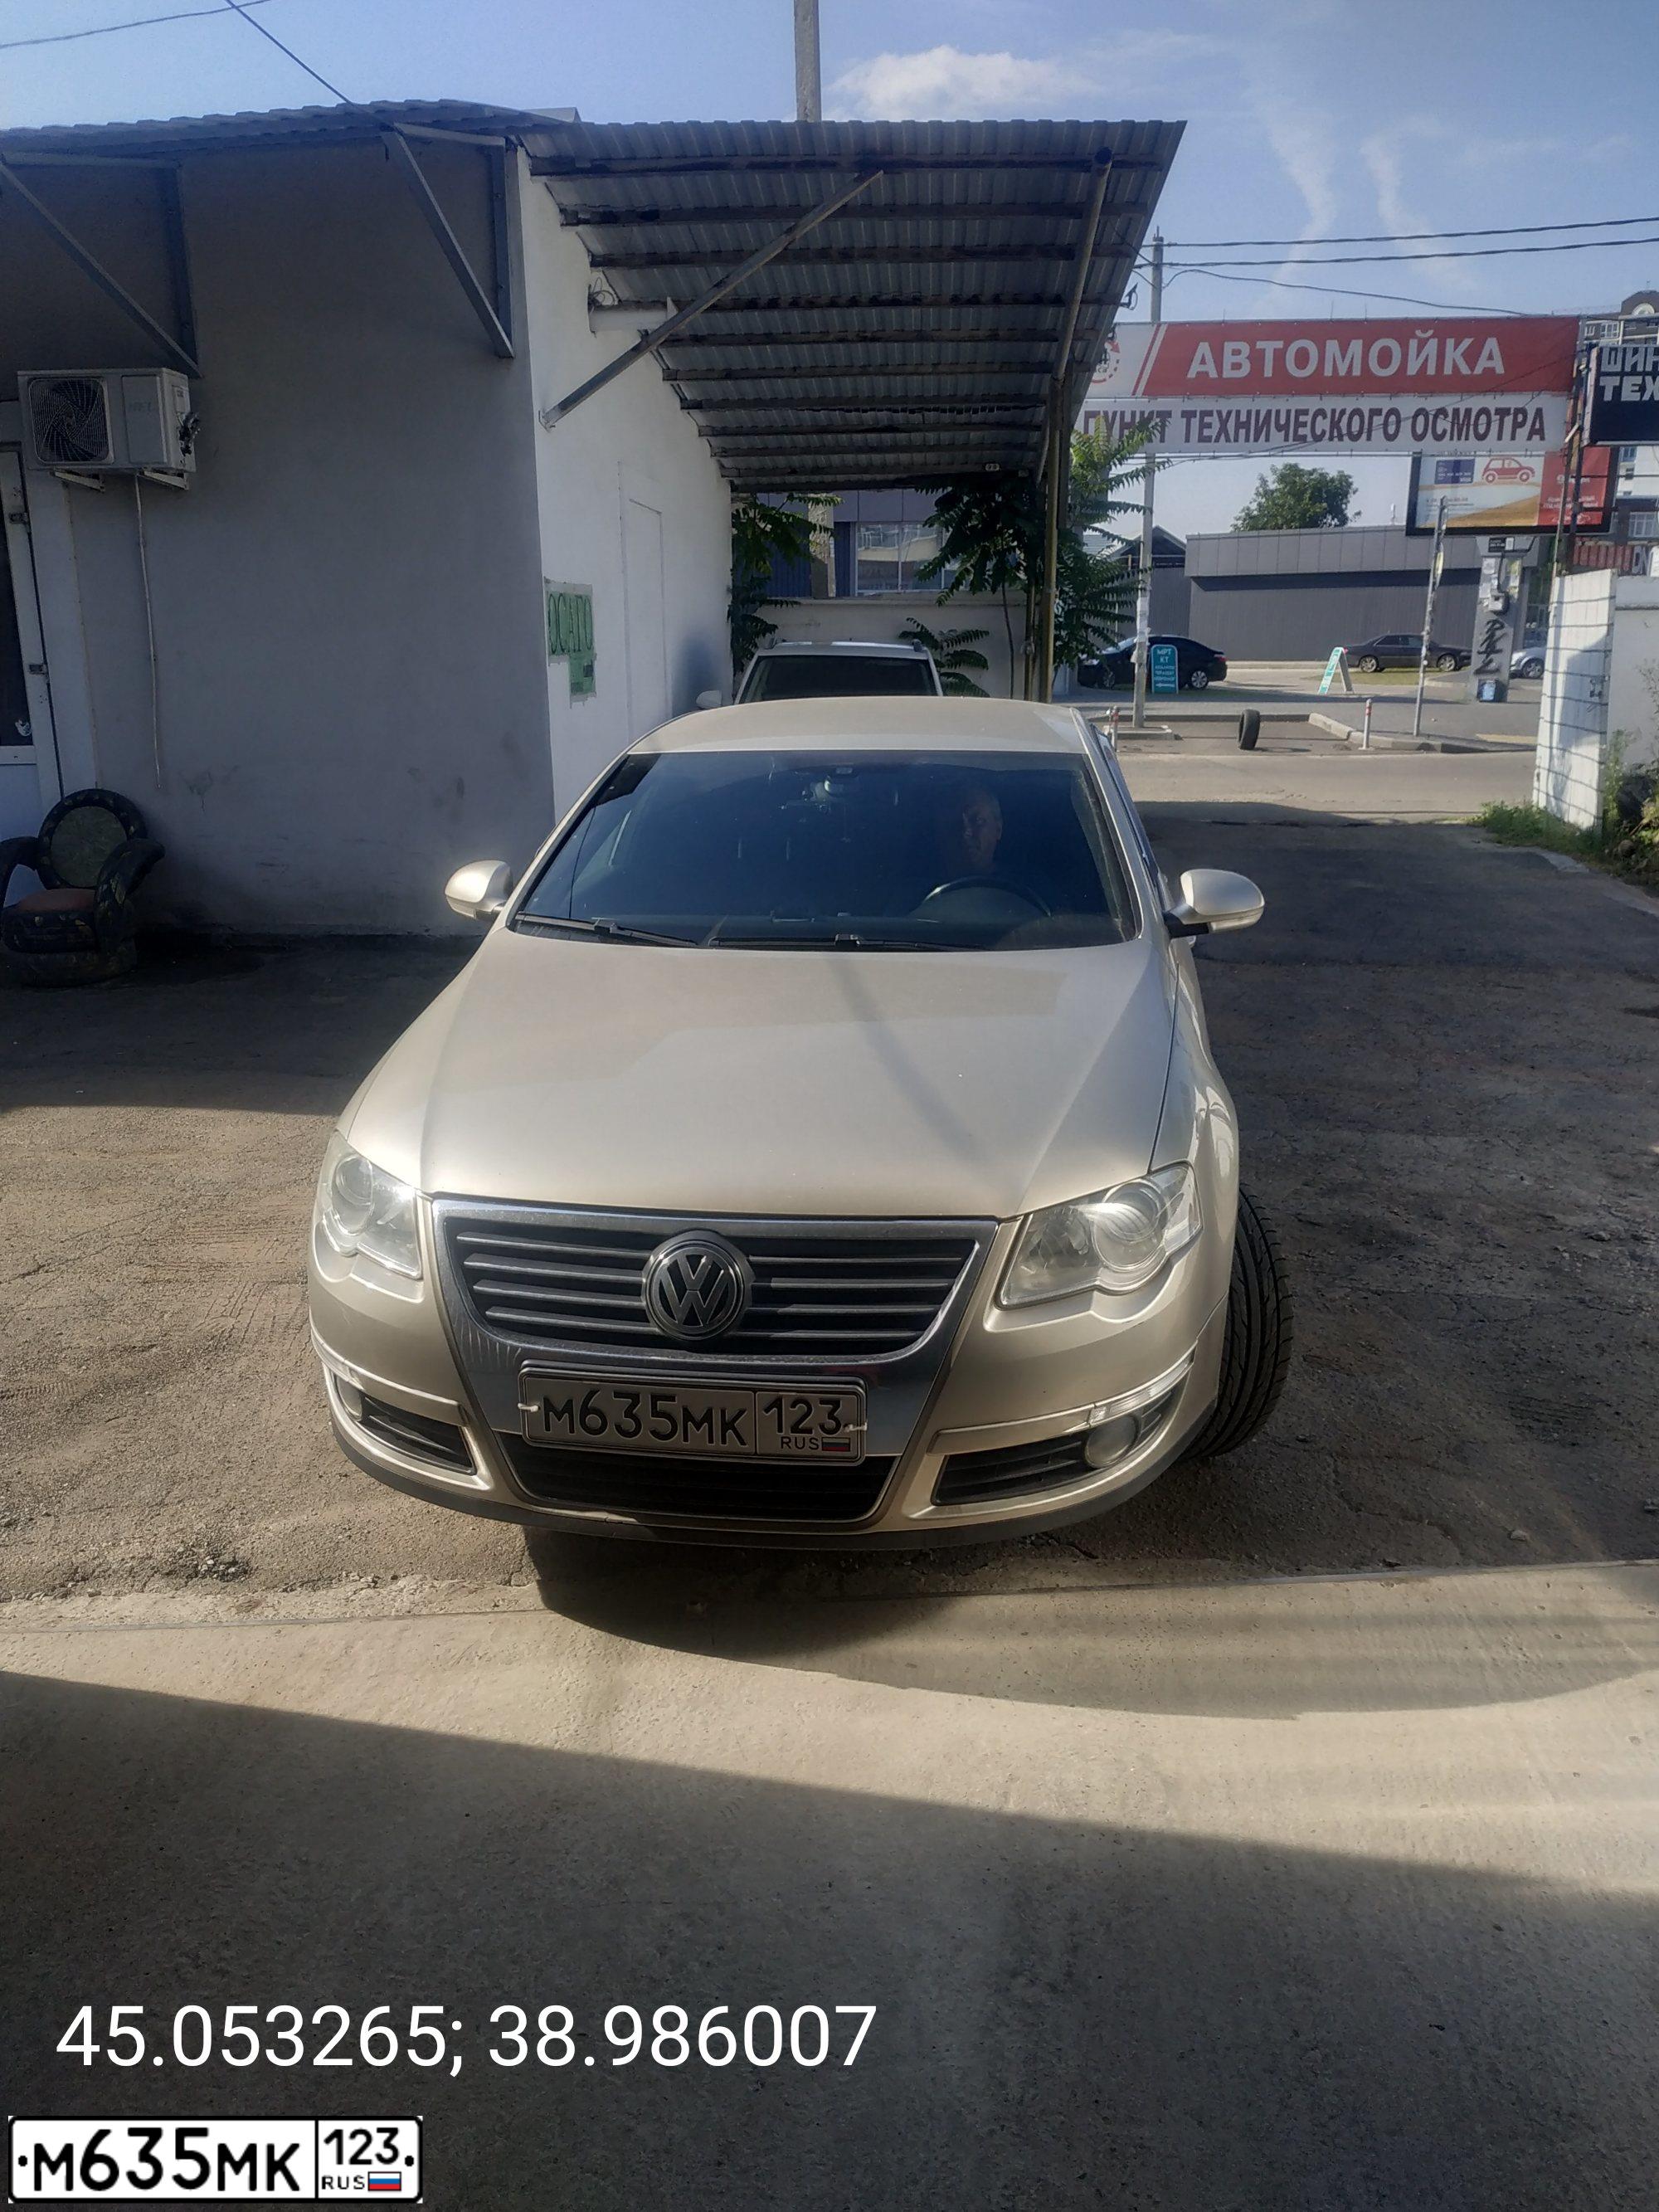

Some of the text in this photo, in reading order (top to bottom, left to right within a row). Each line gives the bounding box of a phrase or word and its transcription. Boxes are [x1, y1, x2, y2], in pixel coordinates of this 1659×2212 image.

[1186, 329, 1506, 379] АВТОМОЙКА
[1598, 375, 1659, 402] ТЕХ
[1180, 407, 1402, 444] ТЕХНИЧЕСКОГО
[1410, 406, 1546, 442] ОСМОТРА
[542, 1389, 844, 1447] М635МК 123
[781, 1436, 820, 1450] RUS
